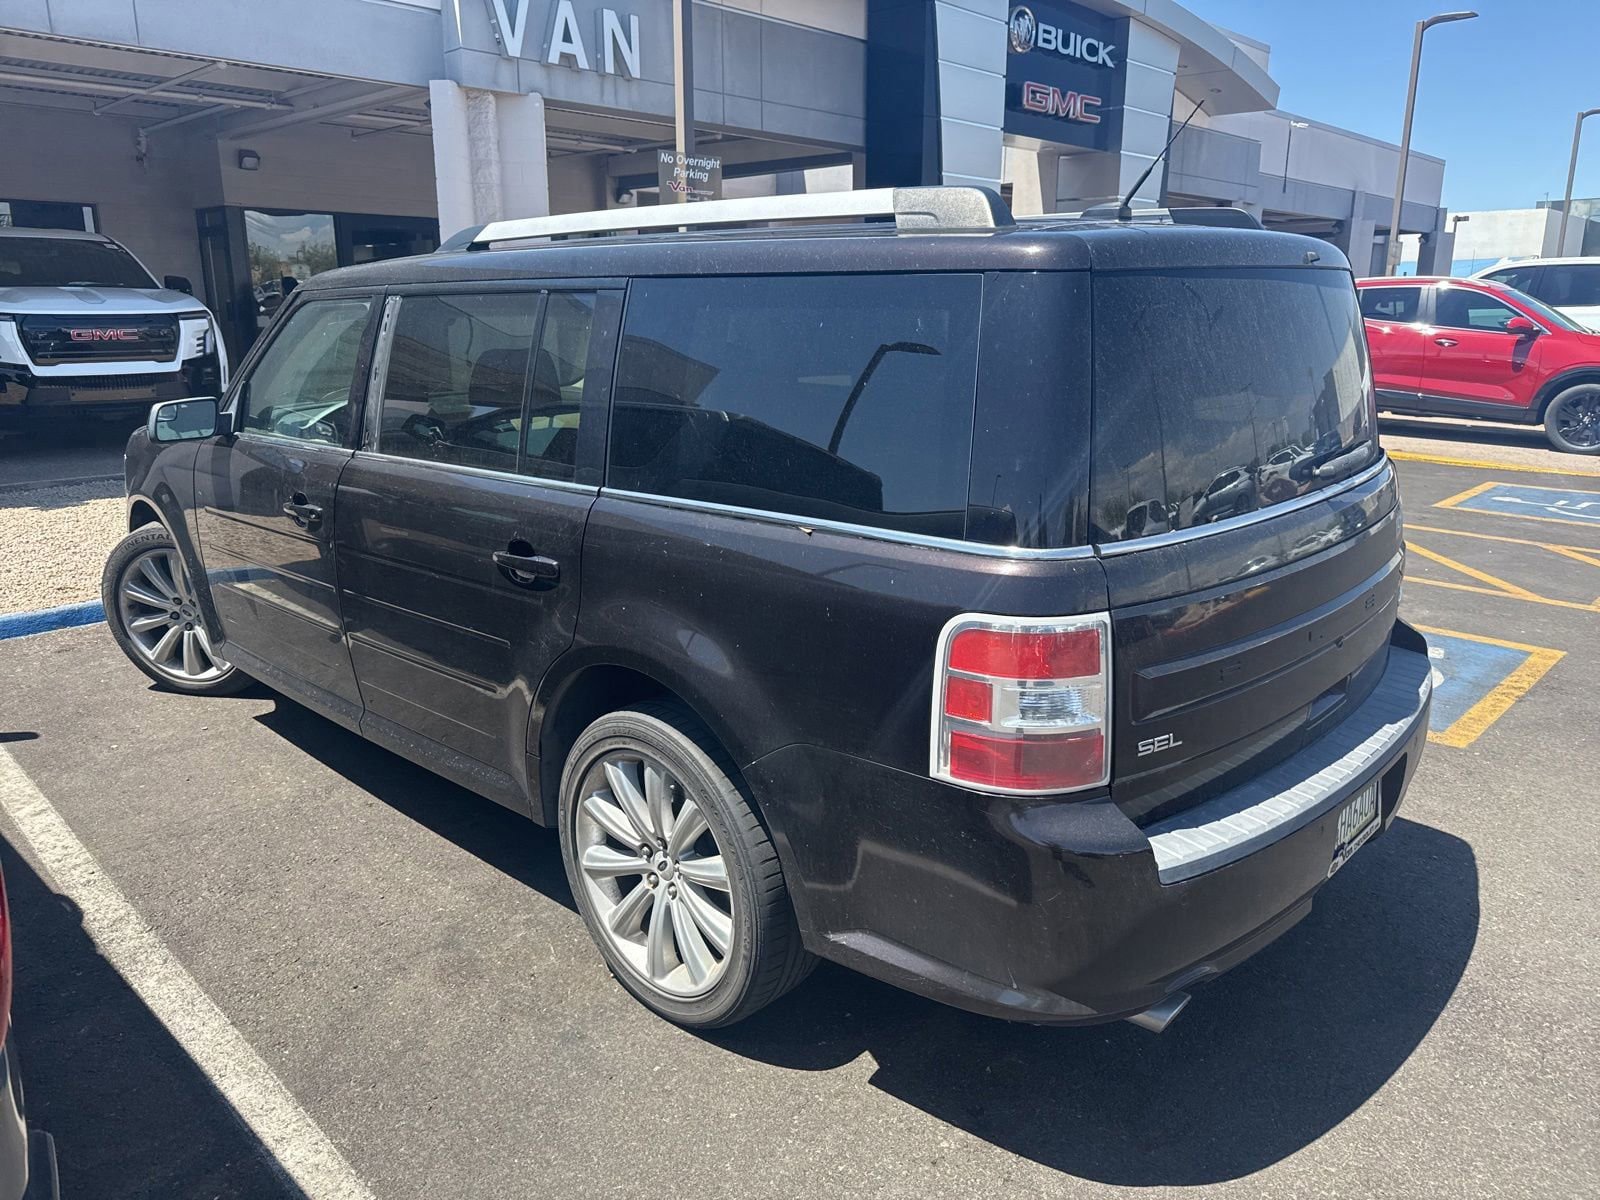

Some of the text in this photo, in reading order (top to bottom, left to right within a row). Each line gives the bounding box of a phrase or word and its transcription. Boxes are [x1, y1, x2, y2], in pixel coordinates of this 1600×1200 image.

[492, 0, 641, 79] VAN
[1037, 22, 1116, 68] BUICK
[1023, 81, 1102, 124] GMC
[660, 152, 721, 170] No Overnight
[673, 167, 709, 183] Parking
[666, 180, 694, 193] Van
[70, 328, 139, 341] GMC
[1137, 733, 1183, 757] SEL
